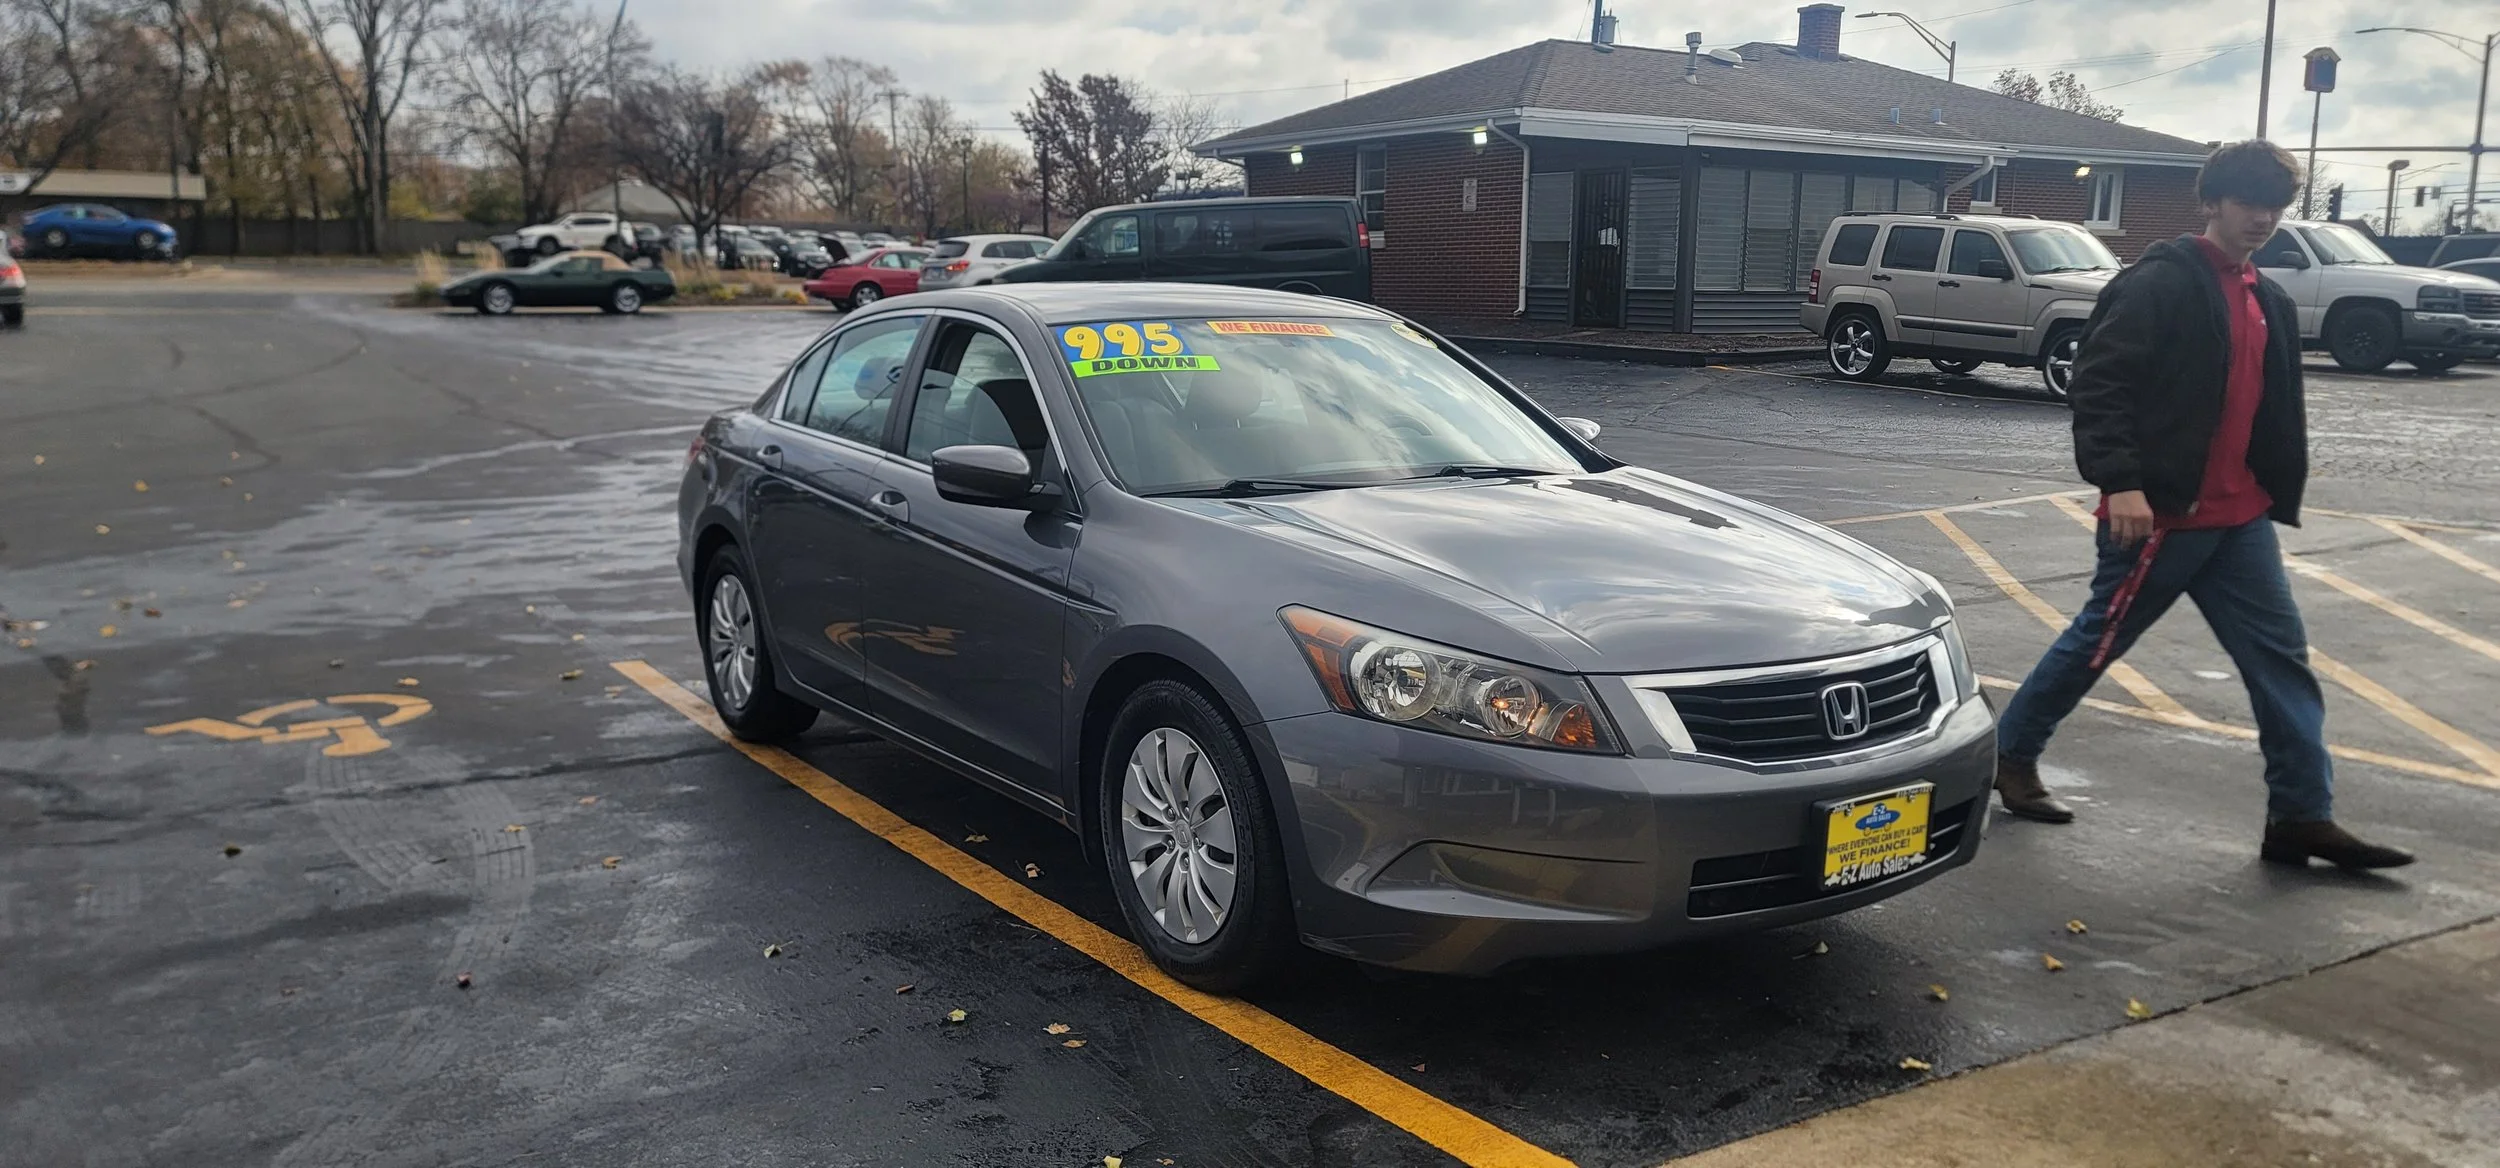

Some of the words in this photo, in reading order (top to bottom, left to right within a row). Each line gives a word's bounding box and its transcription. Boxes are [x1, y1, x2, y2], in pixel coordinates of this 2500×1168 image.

[1216, 322, 1246, 333] WE
[1250, 322, 1325, 335] FINANCE
[1064, 323, 1182, 359] 995
[1092, 356, 1198, 372] DOWN
[1866, 815, 1877, 824] AUTO
[1878, 813, 1891, 821] SALES
[1850, 836, 1880, 850] EVERYONE
[1881, 833, 1892, 842] CAN
[1893, 830, 1905, 840] BUY
[1906, 828, 1910, 837] A
[1839, 851, 1856, 863] WE
[1860, 839, 1911, 858] FINANCE!
[1859, 859, 1881, 881] Auto
[1882, 854, 1909, 875] Sales
